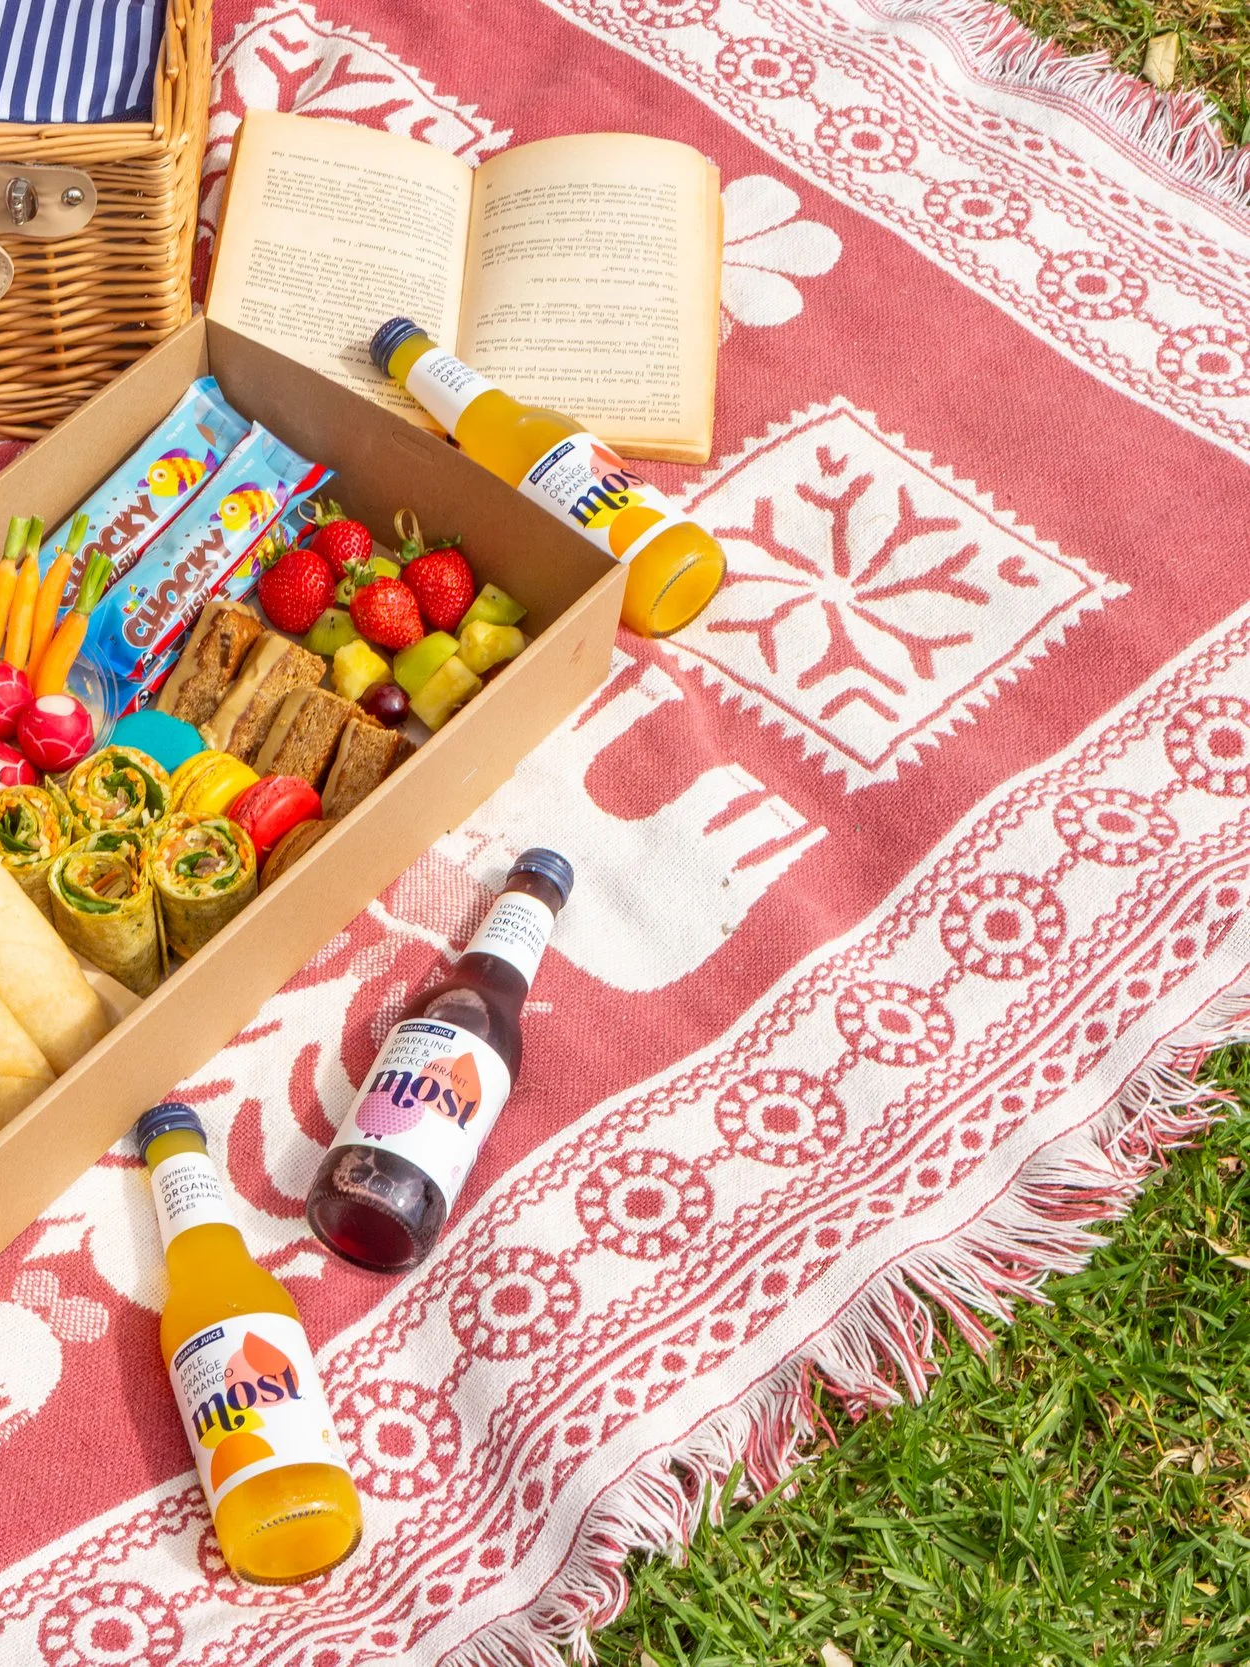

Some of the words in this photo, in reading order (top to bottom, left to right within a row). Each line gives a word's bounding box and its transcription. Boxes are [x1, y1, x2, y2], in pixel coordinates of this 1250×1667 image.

[530, 457, 556, 482] ORGANIC
[556, 442, 573, 460] JUICE
[549, 463, 586, 499] ORANGE
[557, 498, 566, 506] &
[564, 466, 600, 498] MANGO
[568, 467, 645, 529] mos
[123, 527, 232, 648] CHOCKY
[181, 586, 212, 626] FISH
[496, 910, 531, 925] CRAFTED
[499, 903, 538, 919] LOVINGLY
[485, 934, 514, 945] APPLES
[492, 917, 542, 951] ORGANIC
[392, 1035, 453, 1054] SPARKLING
[400, 1023, 430, 1032] ORGANIC
[431, 1027, 454, 1037] JUICE
[387, 1046, 419, 1055] APPLE
[421, 1050, 430, 1058] &
[382, 1056, 469, 1089] BLACKCURRANT
[367, 1069, 477, 1130] most
[159, 1165, 196, 1186] LOVINGLY
[161, 1173, 195, 1194] CRAFTED
[163, 1182, 222, 1204] ORGANIC
[166, 1199, 182, 1212] NEW
[185, 1192, 223, 1201] ZEALAND
[169, 1202, 196, 1220] APPLES
[175, 1340, 199, 1367] ORGANIC
[200, 1329, 222, 1346] JUICE
[183, 1359, 223, 1395] ORANGE
[187, 1398, 193, 1408] &
[192, 1367, 234, 1399] MANGO
[191, 1364, 303, 1443] most
